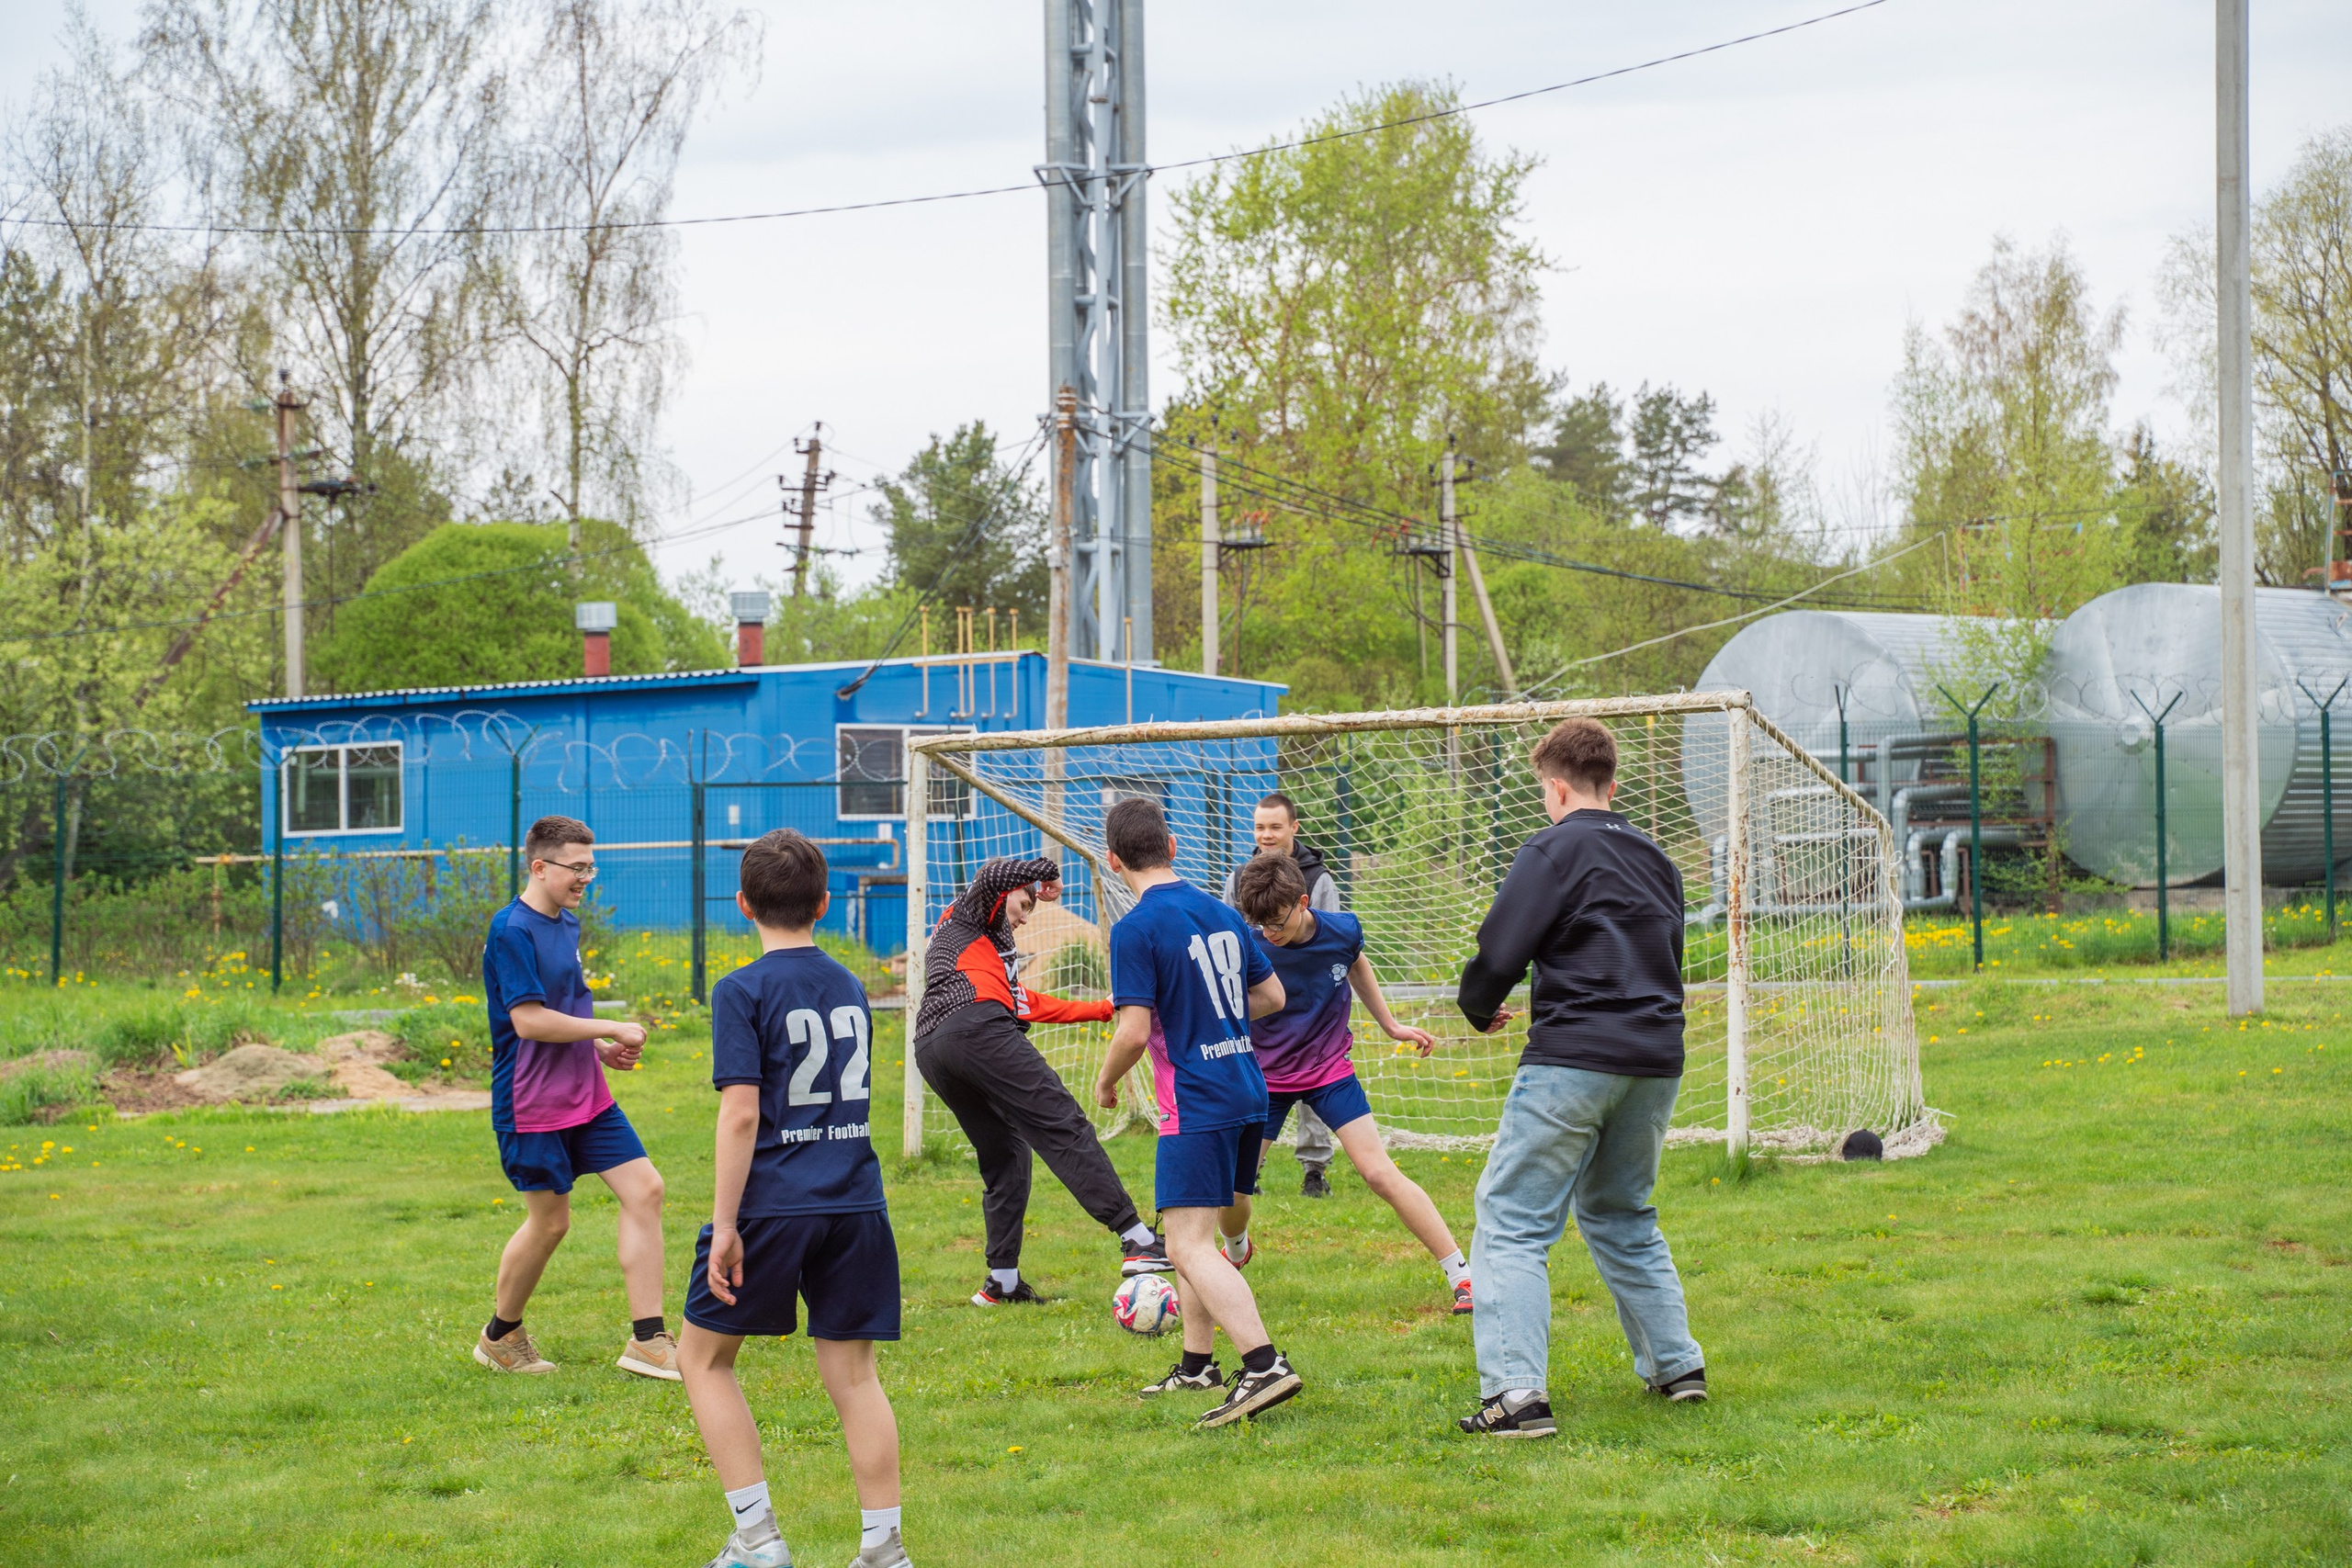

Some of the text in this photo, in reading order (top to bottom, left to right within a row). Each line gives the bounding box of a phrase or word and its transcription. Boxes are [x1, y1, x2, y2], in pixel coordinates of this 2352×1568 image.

[1187, 931, 1244, 1020] 18
[786, 1005, 870, 1106] 22
[781, 1122, 870, 1145] Premier Football
[1483, 1402, 1506, 1425] N
